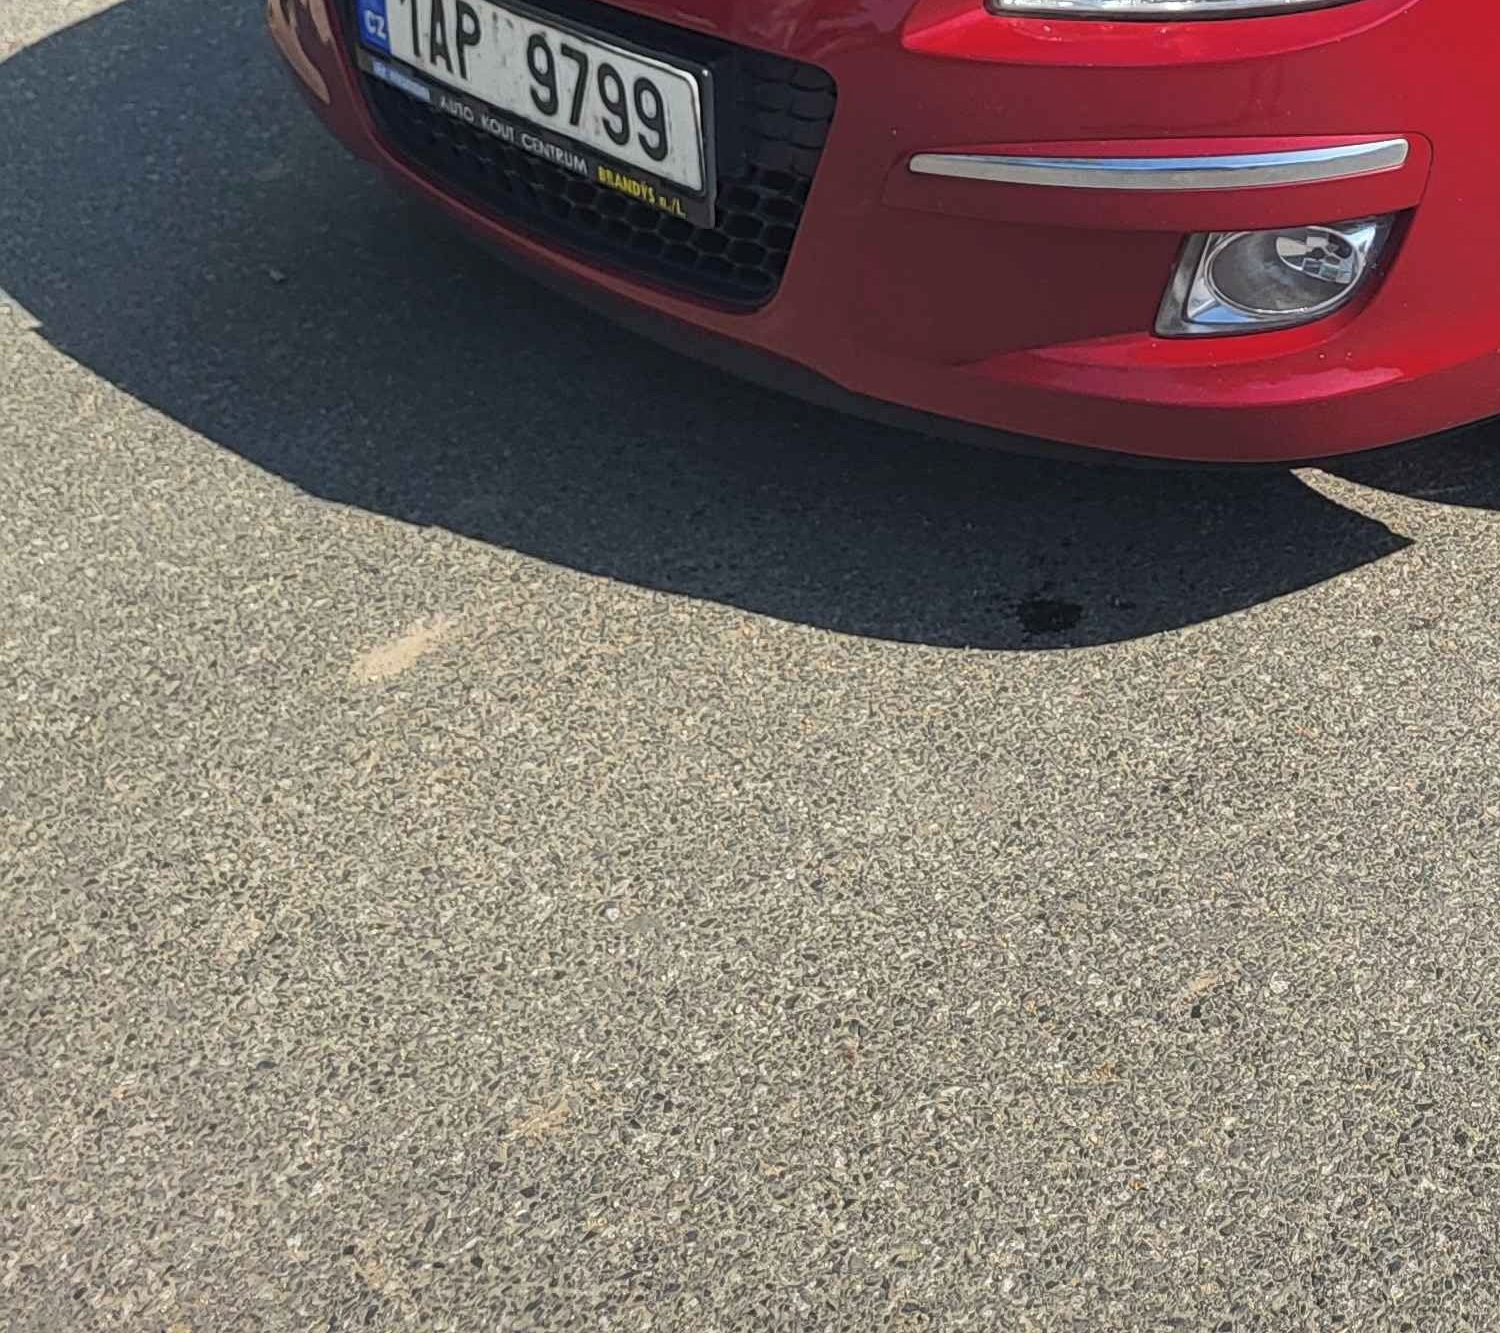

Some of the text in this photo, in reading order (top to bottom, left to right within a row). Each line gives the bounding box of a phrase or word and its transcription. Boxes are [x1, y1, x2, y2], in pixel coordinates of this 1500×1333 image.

[364, 9, 387, 40] CZ
[440, 96, 474, 124] AUTO
[522, 134, 588, 174] CENTRUM
[527, 34, 668, 162] 9799
